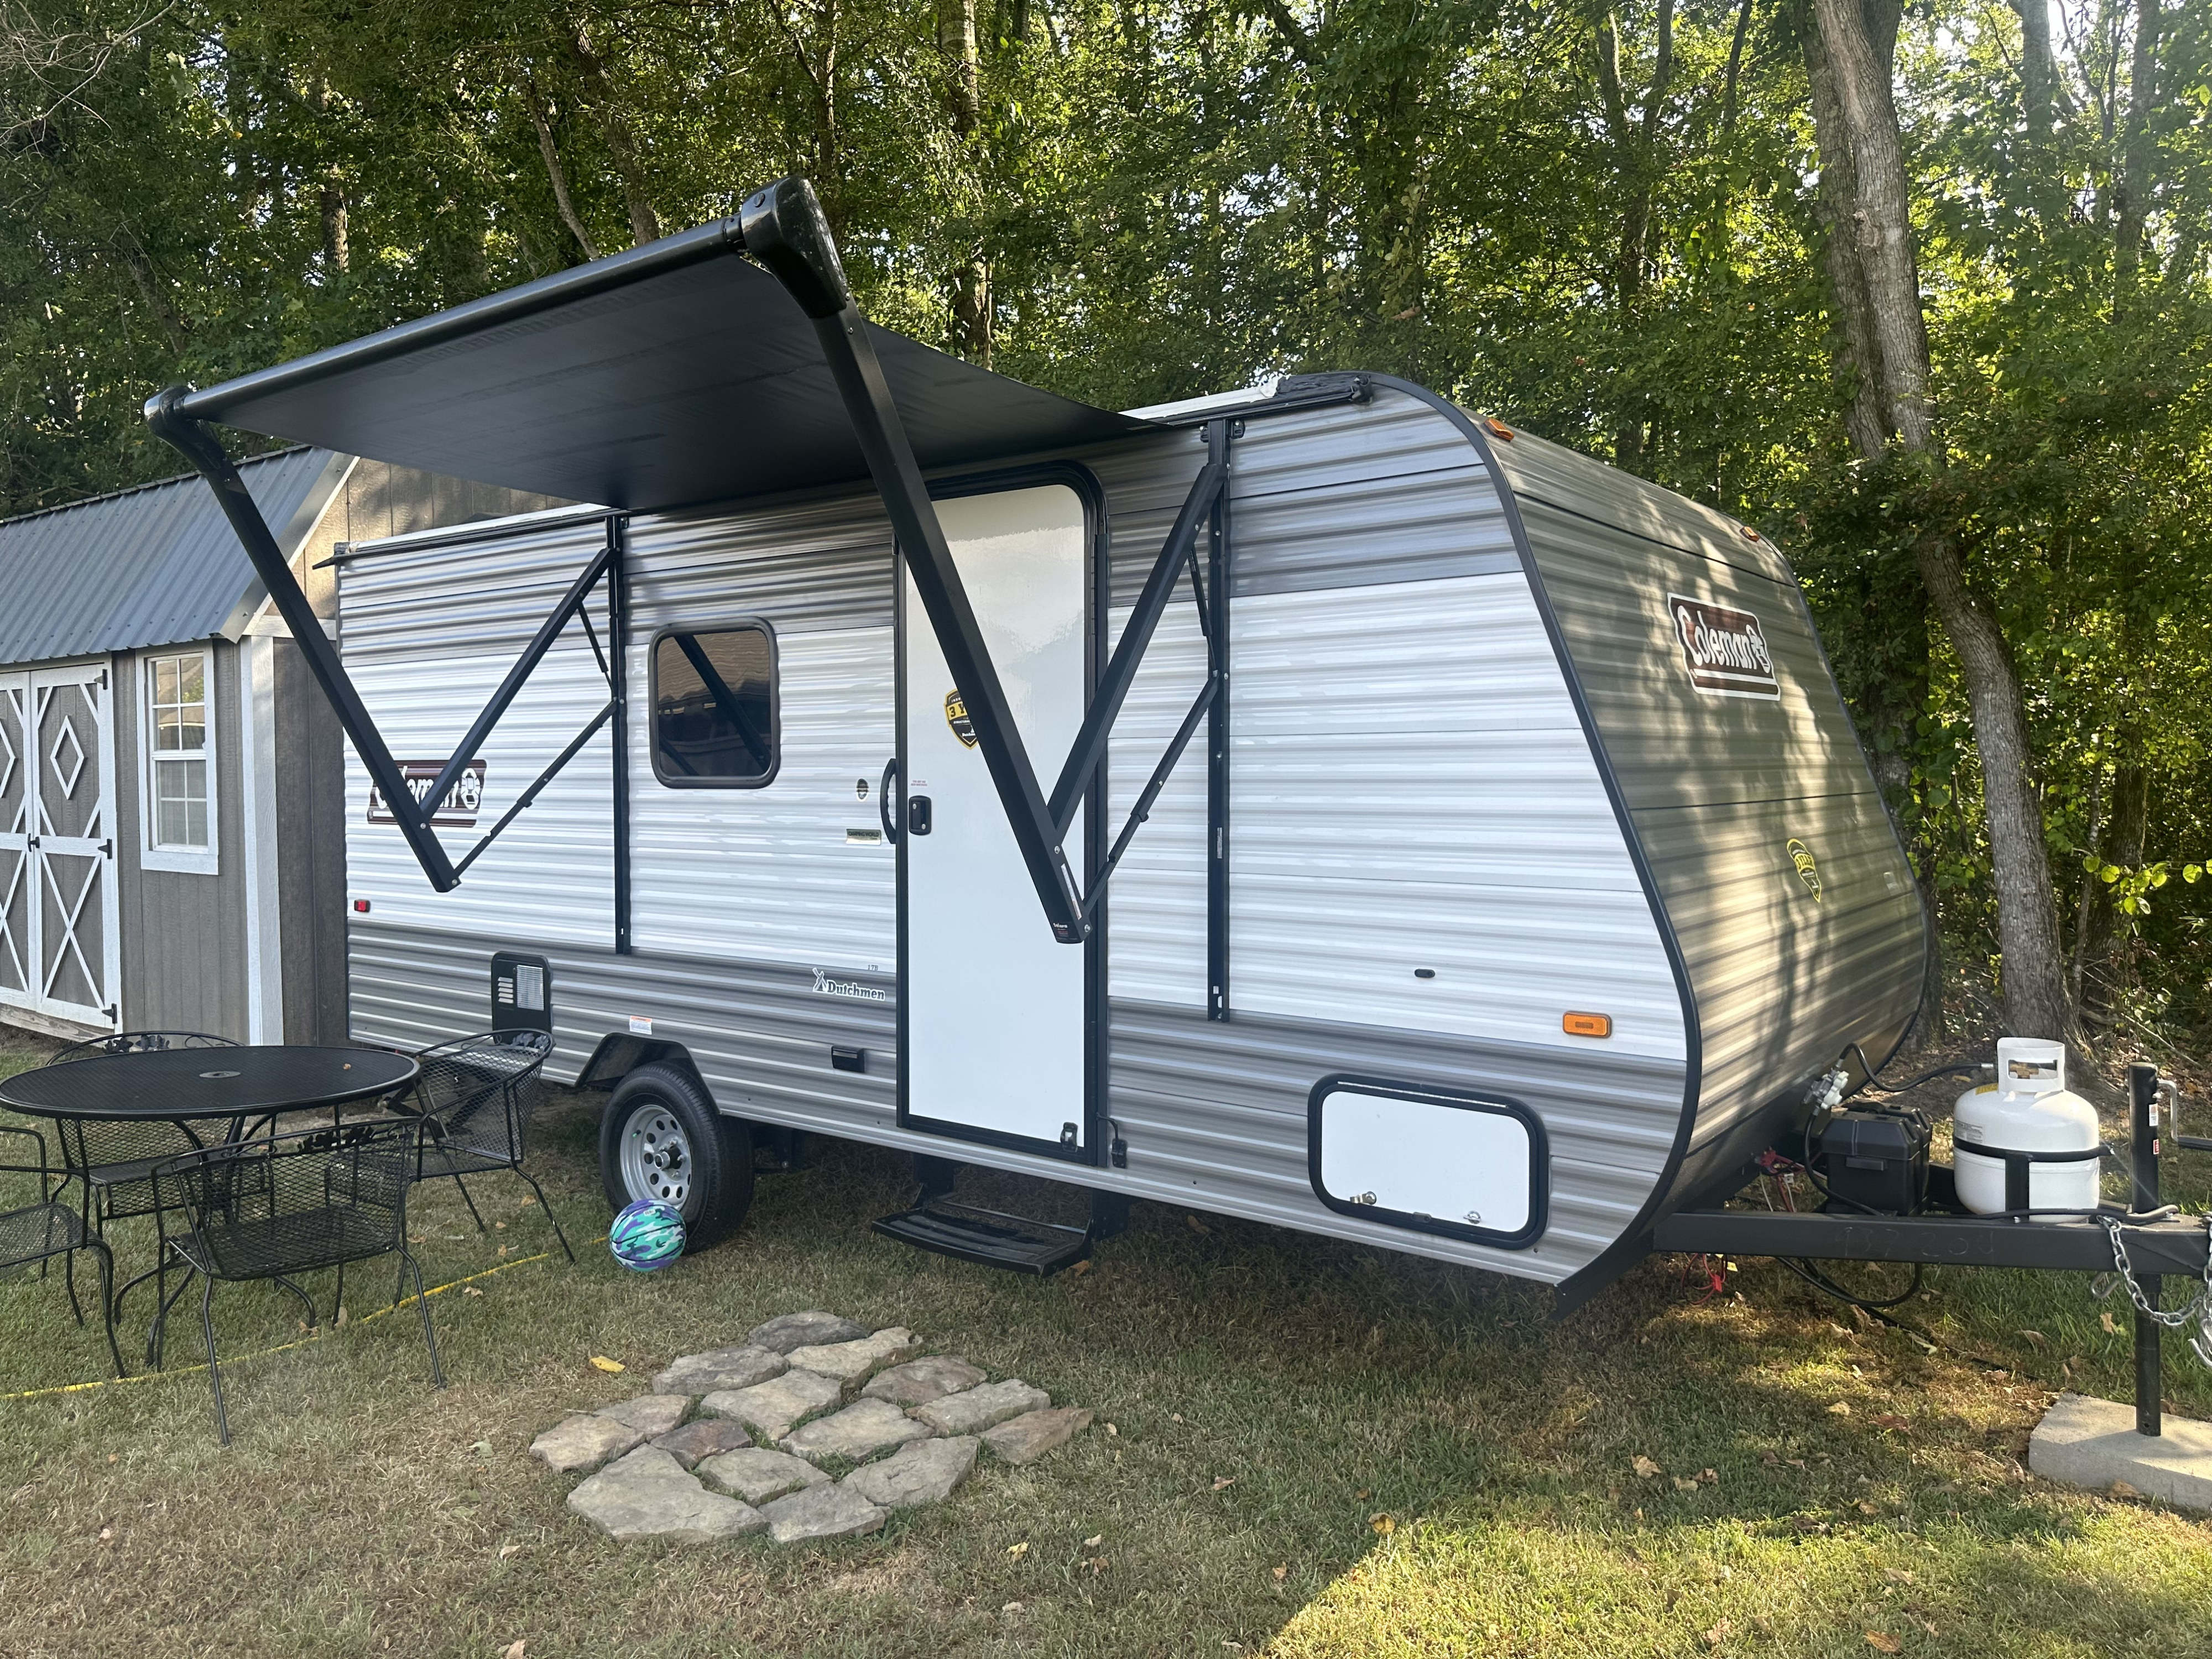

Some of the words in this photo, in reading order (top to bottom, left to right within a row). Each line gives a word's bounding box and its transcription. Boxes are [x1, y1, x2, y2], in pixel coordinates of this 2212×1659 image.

[1677, 605, 1757, 670] Coleman
[950, 706, 956, 717] 3
[827, 981, 885, 1000] Dutchmen
